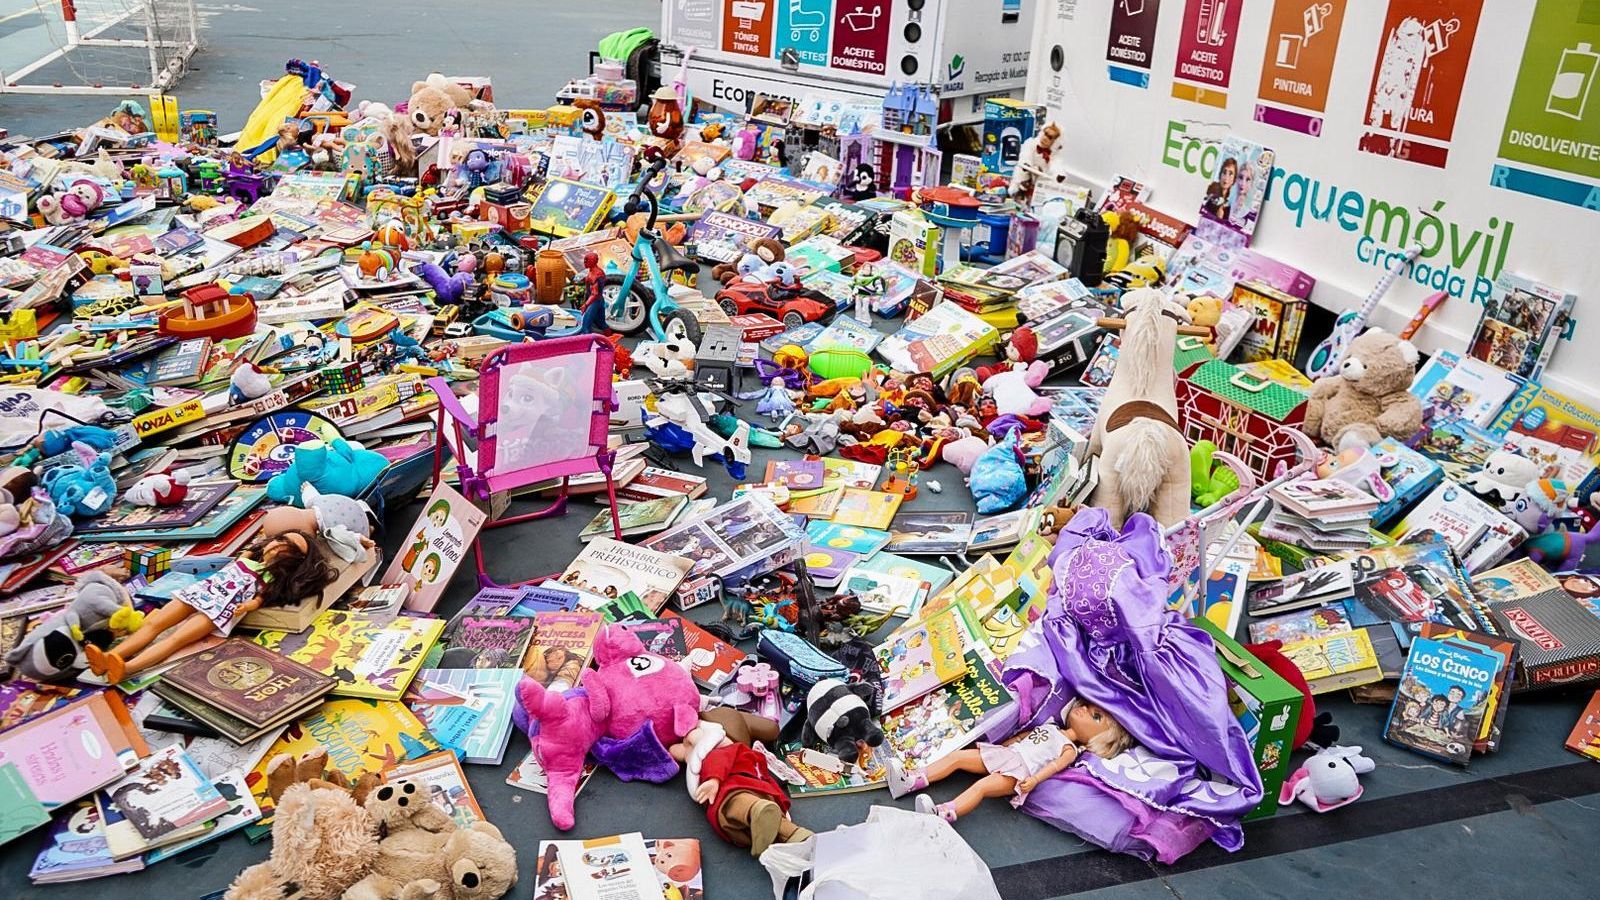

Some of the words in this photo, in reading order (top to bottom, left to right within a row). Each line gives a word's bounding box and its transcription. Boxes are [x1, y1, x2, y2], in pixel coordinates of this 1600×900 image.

[734, 31, 760, 43] TÓNER
[1118, 34, 1141, 48] ACEITE
[733, 42, 759, 53] TINTAS
[843, 46, 875, 58] ACEITE
[1110, 46, 1146, 63] DOMÉSTICO
[833, 56, 885, 73] DOMÉSTICO
[1190, 50, 1218, 65] ACEITE
[1181, 61, 1224, 82] DOMÉSTICO
[1273, 77, 1313, 97] PINTURA
[706, 214, 769, 238] MONOPOLY
[1147, 217, 1179, 239] Juegos
[1254, 306, 1268, 316] TAC
[133, 412, 175, 434] MONZA
[285, 417, 296, 426] 10
[433, 535, 444, 550] da
[442, 541, 461, 564] Vinci
[610, 544, 663, 565] HOMBRE
[534, 593, 568, 603] AVENTURAS
[537, 629, 586, 639] PRINCESA
[536, 638, 585, 648] DESIERTO
[1413, 651, 1440, 669] LOS
[1442, 657, 1489, 682] CINCO
[1535, 658, 1598, 682] ESCRUPULOS
[244, 673, 300, 702] THOR
[976, 679, 1000, 705] siete
